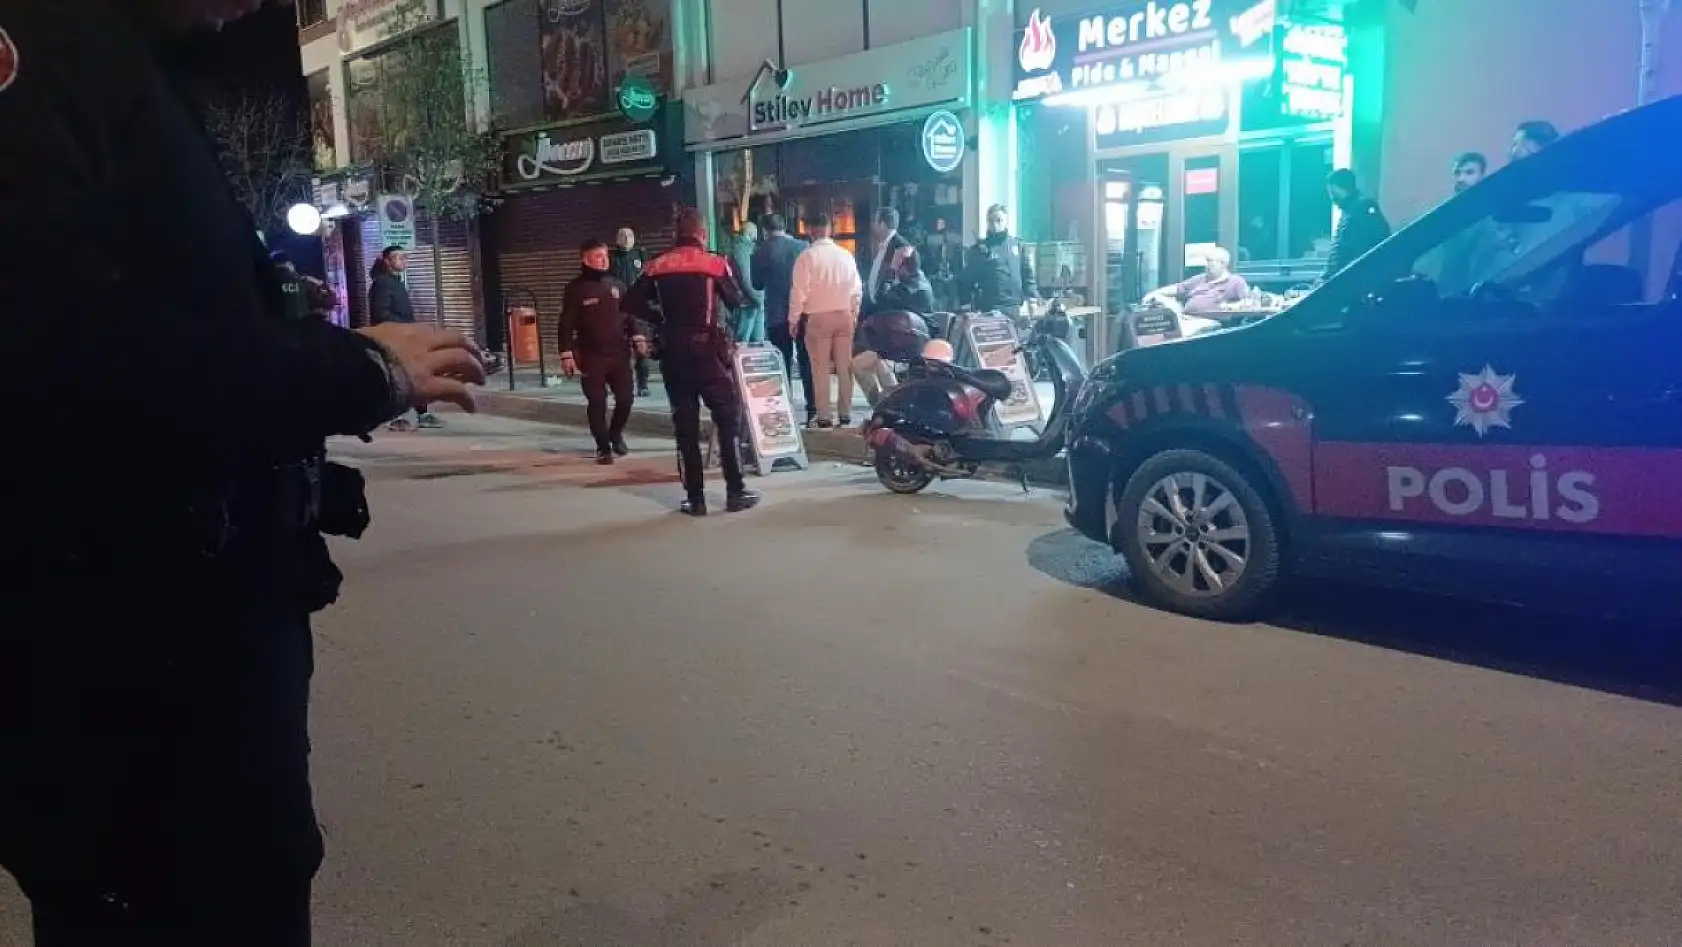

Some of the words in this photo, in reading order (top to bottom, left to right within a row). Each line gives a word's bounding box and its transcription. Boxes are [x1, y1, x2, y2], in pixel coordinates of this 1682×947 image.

[1079, 0, 1213, 51] Merkez
[1071, 61, 1116, 88] Pide
[1120, 59, 1135, 79] &
[817, 83, 888, 113] Home
[1388, 454, 1600, 523] POLİS
